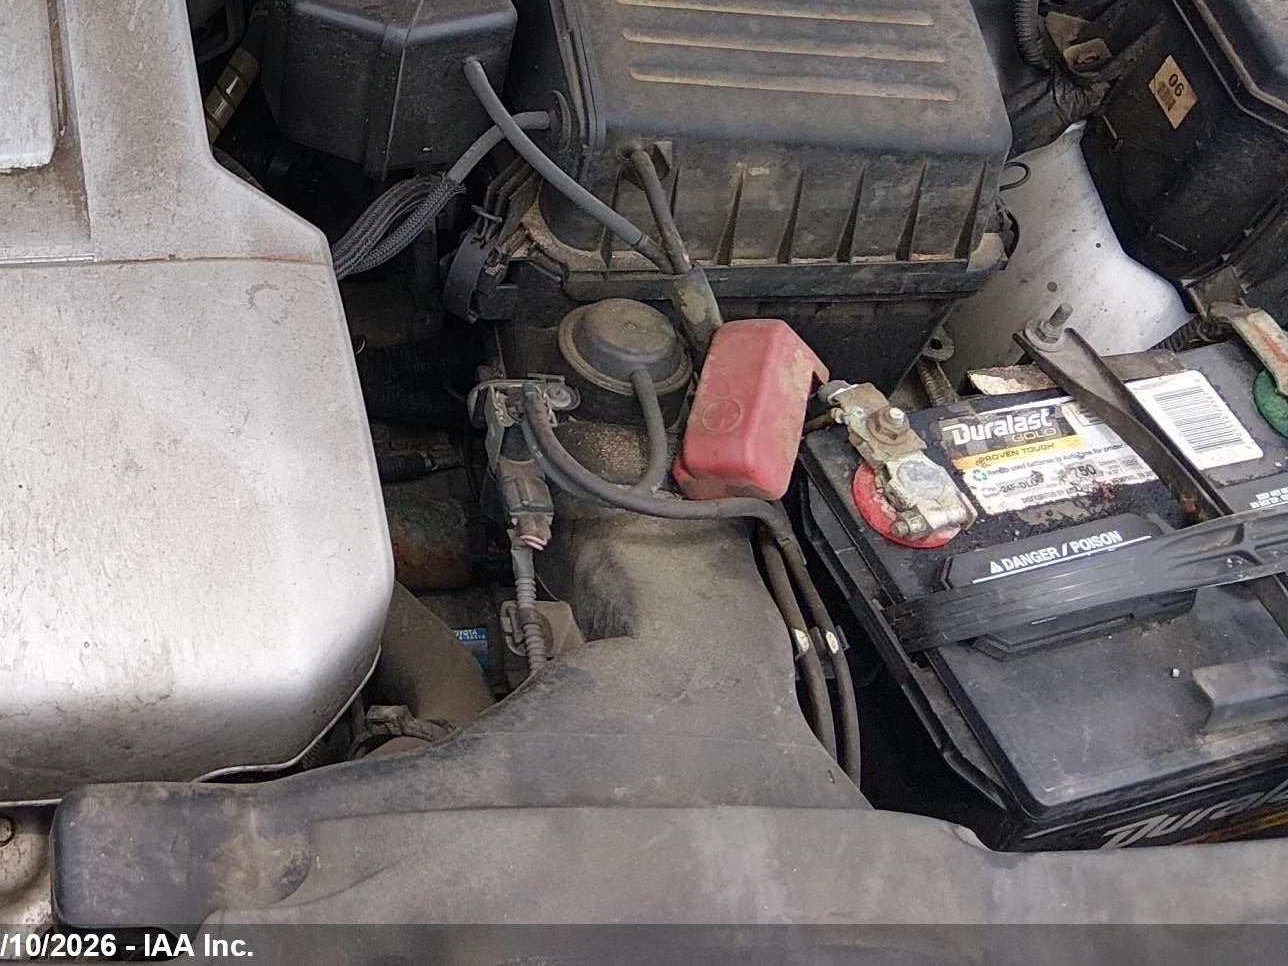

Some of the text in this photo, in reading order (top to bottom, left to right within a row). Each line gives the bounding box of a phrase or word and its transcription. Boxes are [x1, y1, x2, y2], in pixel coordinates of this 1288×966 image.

[942, 407, 1053, 446] Duralast
[1011, 427, 1058, 443] GOLD
[977, 443, 1054, 466] PROVEN TOUGH
[1070, 463, 1097, 478] 750
[1001, 546, 1060, 571] DANGER
[1069, 530, 1123, 554] POISON
